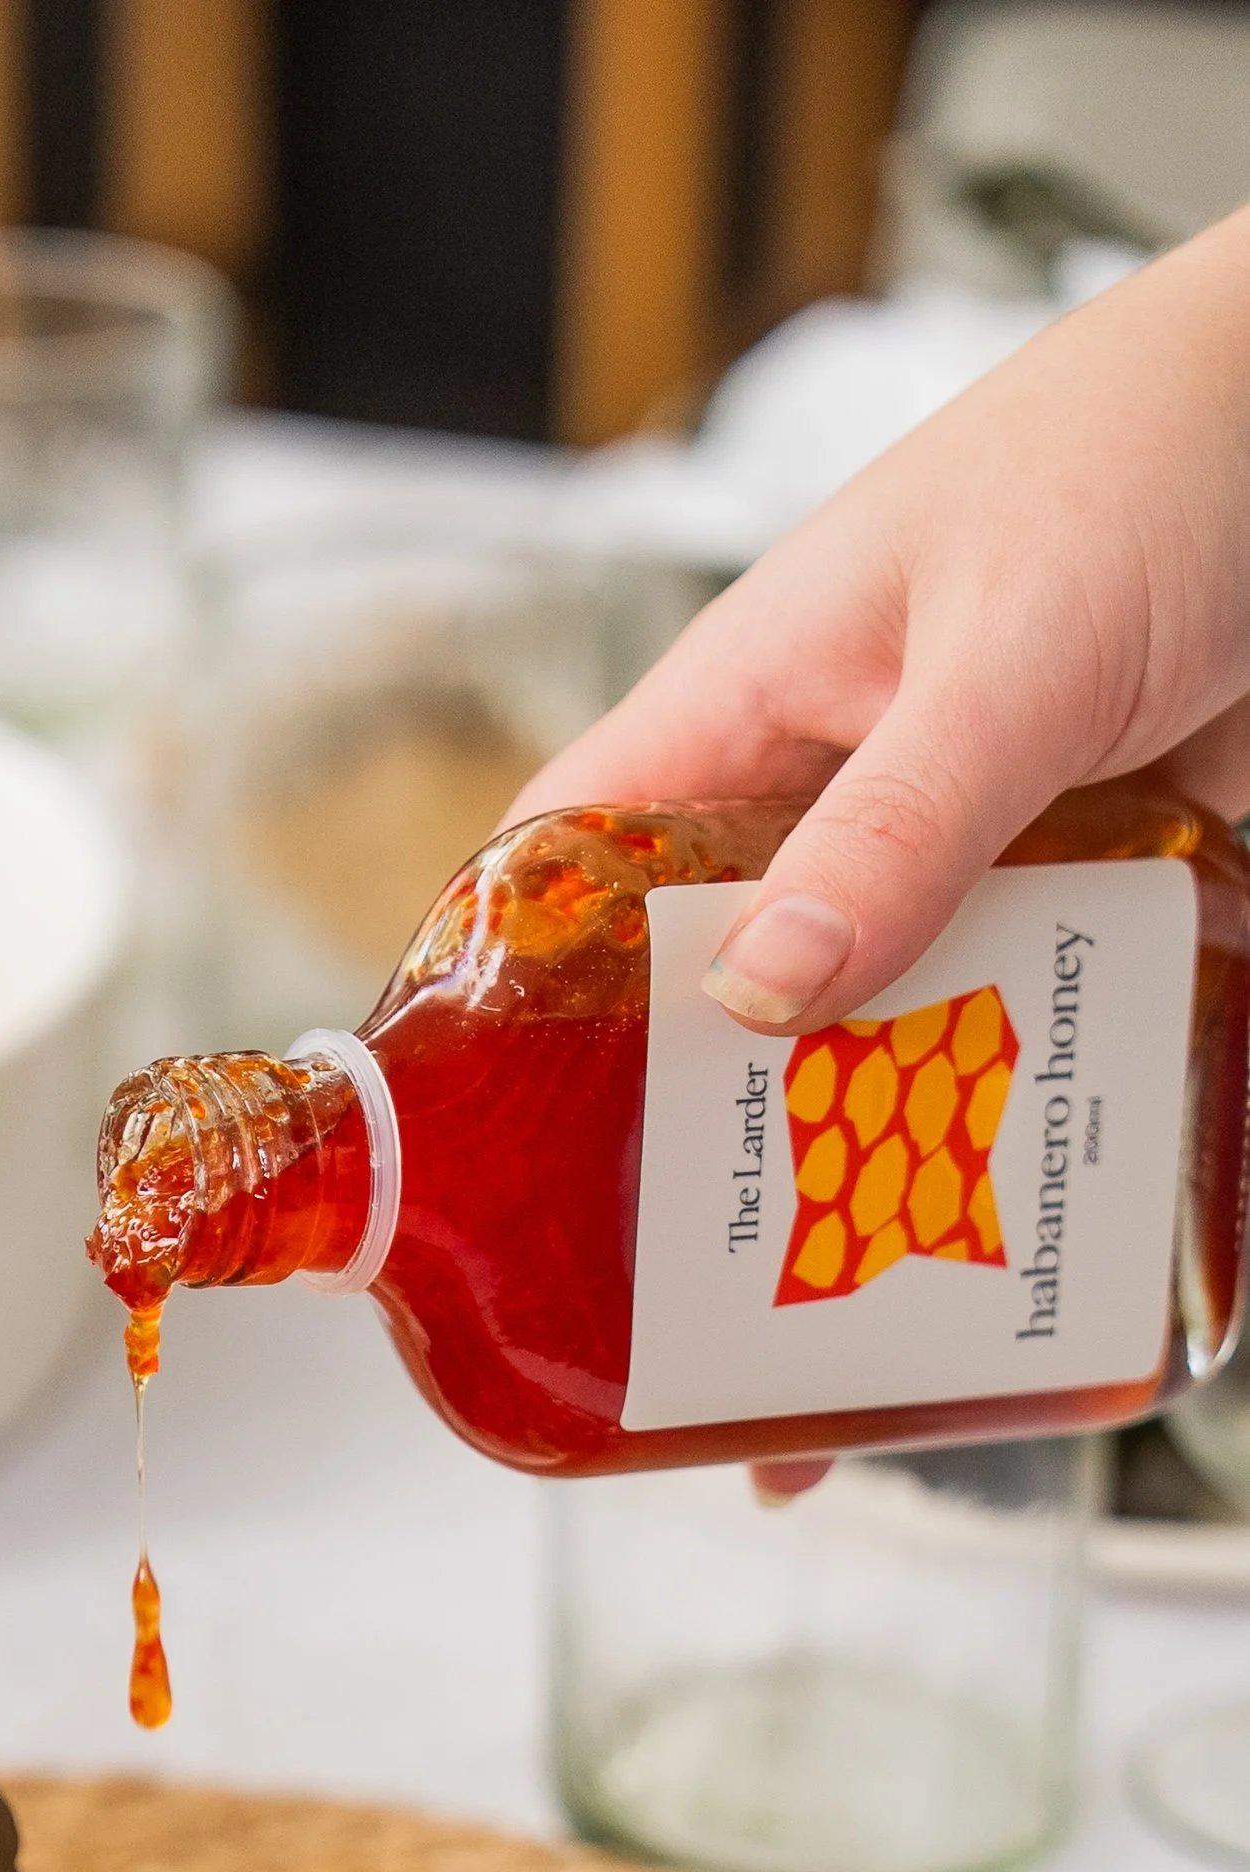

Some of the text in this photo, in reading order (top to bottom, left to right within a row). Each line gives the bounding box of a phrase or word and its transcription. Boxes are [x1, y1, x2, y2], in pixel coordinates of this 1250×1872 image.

[727, 1062, 769, 1254] The Larder
[1015, 922, 1096, 1341] habanero honey
